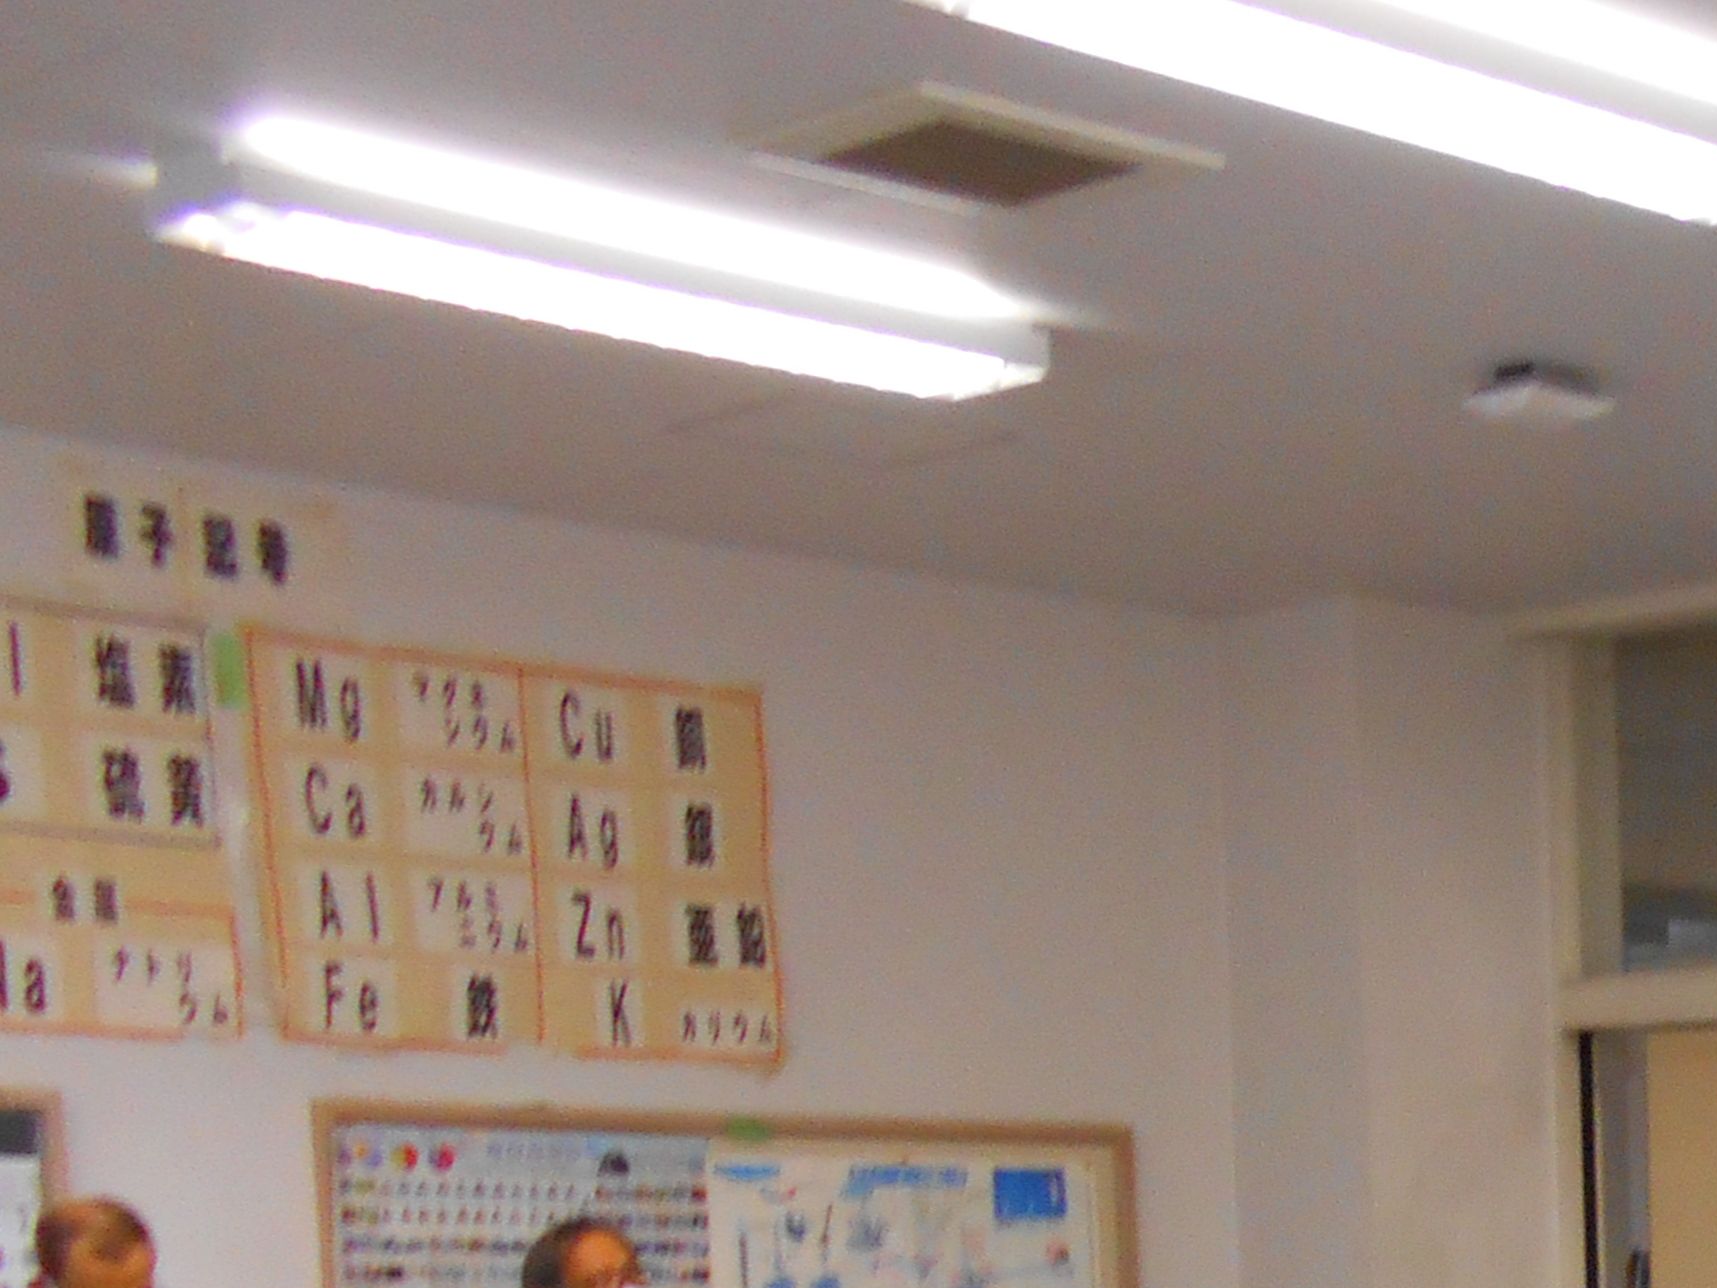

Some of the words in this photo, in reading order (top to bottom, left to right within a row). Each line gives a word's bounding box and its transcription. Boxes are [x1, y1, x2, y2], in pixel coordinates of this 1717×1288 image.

[296, 658, 362, 742] Mg
[561, 689, 614, 762] Cu
[676, 706, 706, 771] 銅
[305, 763, 366, 838] Ca
[569, 794, 618, 870] Ag
[685, 804, 716, 867] 銀
[320, 870, 379, 944] Al
[572, 892, 625, 960] Zn
[686, 903, 766, 968] 亜鉛
[324, 960, 378, 1032] Fe
[467, 973, 498, 1039] 鉄
[611, 979, 632, 1046] K
